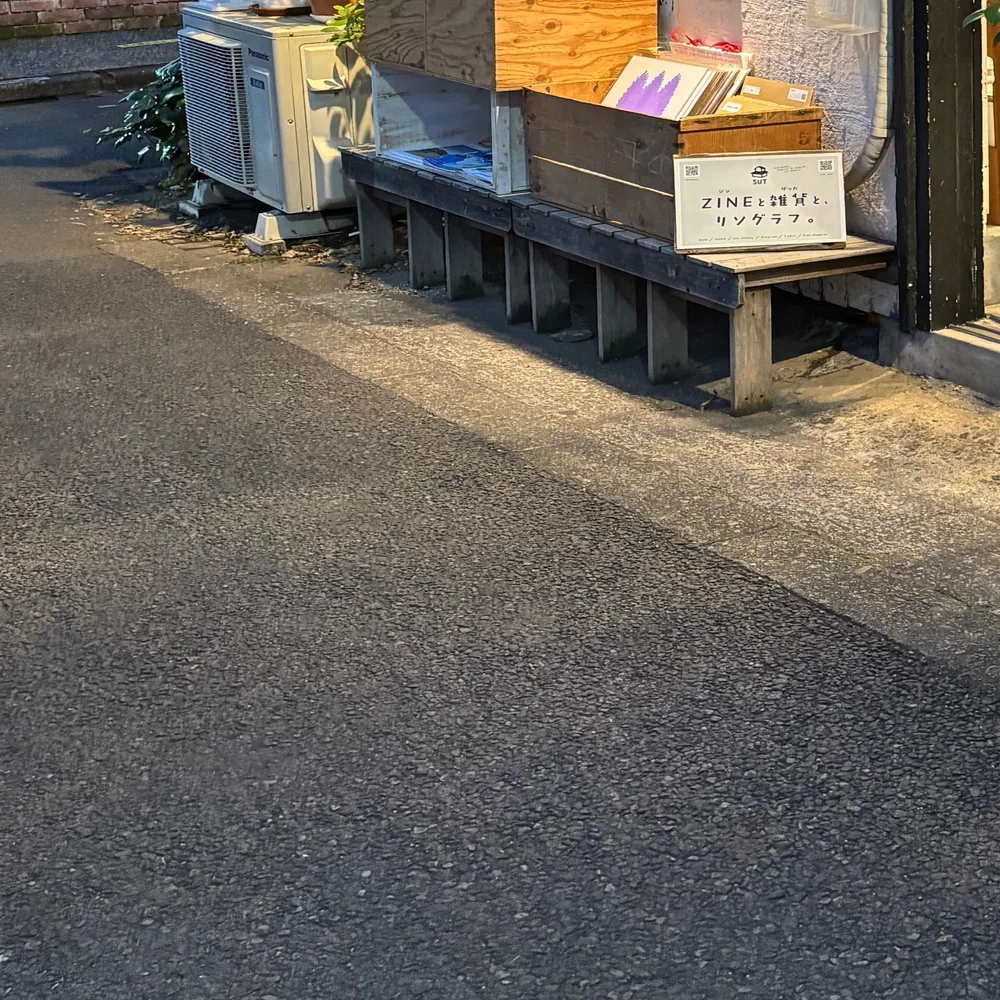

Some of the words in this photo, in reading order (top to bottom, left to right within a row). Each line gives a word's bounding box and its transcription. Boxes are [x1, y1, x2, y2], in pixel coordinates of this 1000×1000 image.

[247, 47, 270, 62] Panasonic
[701, 192, 828, 209] ZINEと雑貨と、
